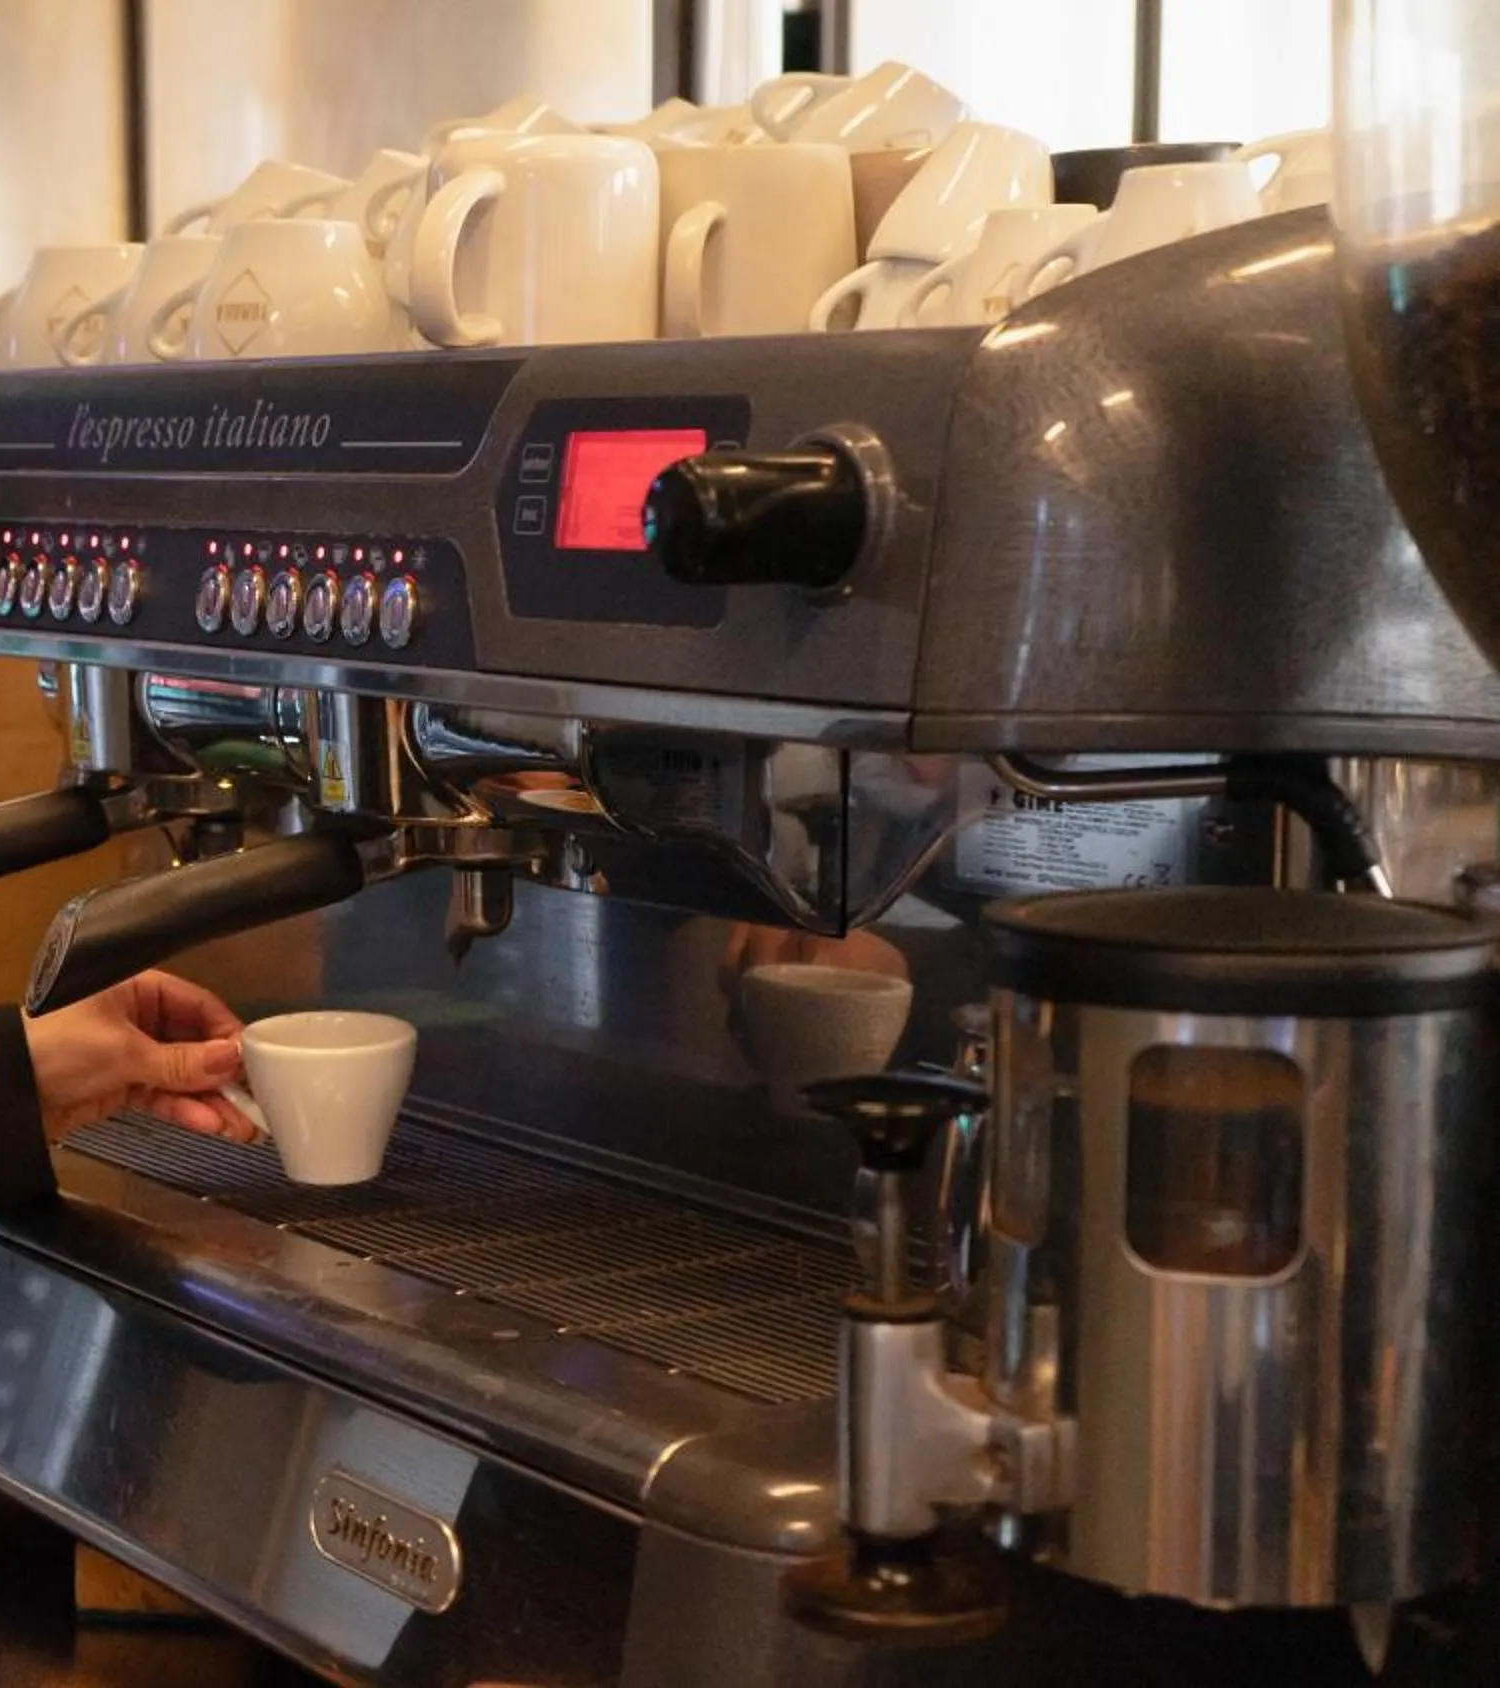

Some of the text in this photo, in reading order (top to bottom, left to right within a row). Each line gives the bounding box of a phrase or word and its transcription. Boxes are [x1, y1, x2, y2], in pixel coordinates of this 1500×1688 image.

[68, 399, 331, 463] l'espresso italiano
[328, 1497, 439, 1584] Sinfonia
